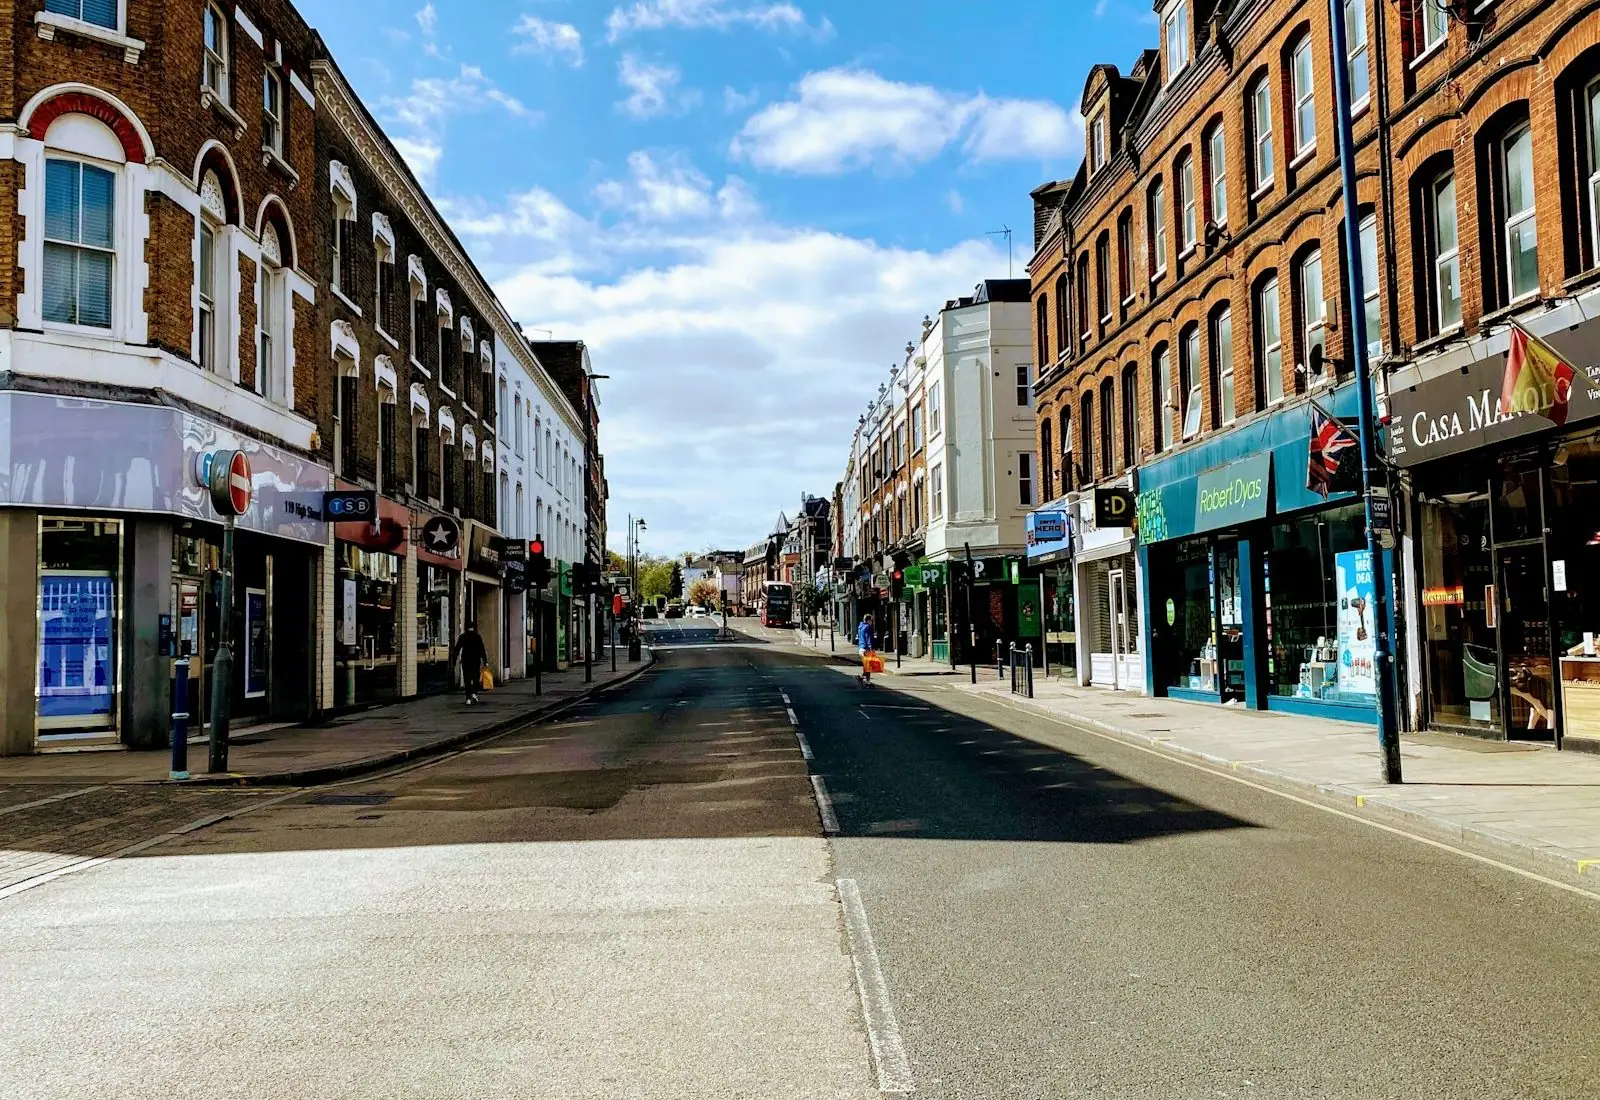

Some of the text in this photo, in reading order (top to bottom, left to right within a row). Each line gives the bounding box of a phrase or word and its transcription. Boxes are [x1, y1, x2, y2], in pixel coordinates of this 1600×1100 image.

[1411, 411, 1464, 447] CASA
[1200, 478, 1262, 514] Robert Dyas
[332, 500, 367, 512] TSB
[1373, 502, 1388, 511] CCTV
[922, 569, 940, 584] PP
[1356, 572, 1373, 584] DEA
[1423, 591, 1463, 602] Restaurant
